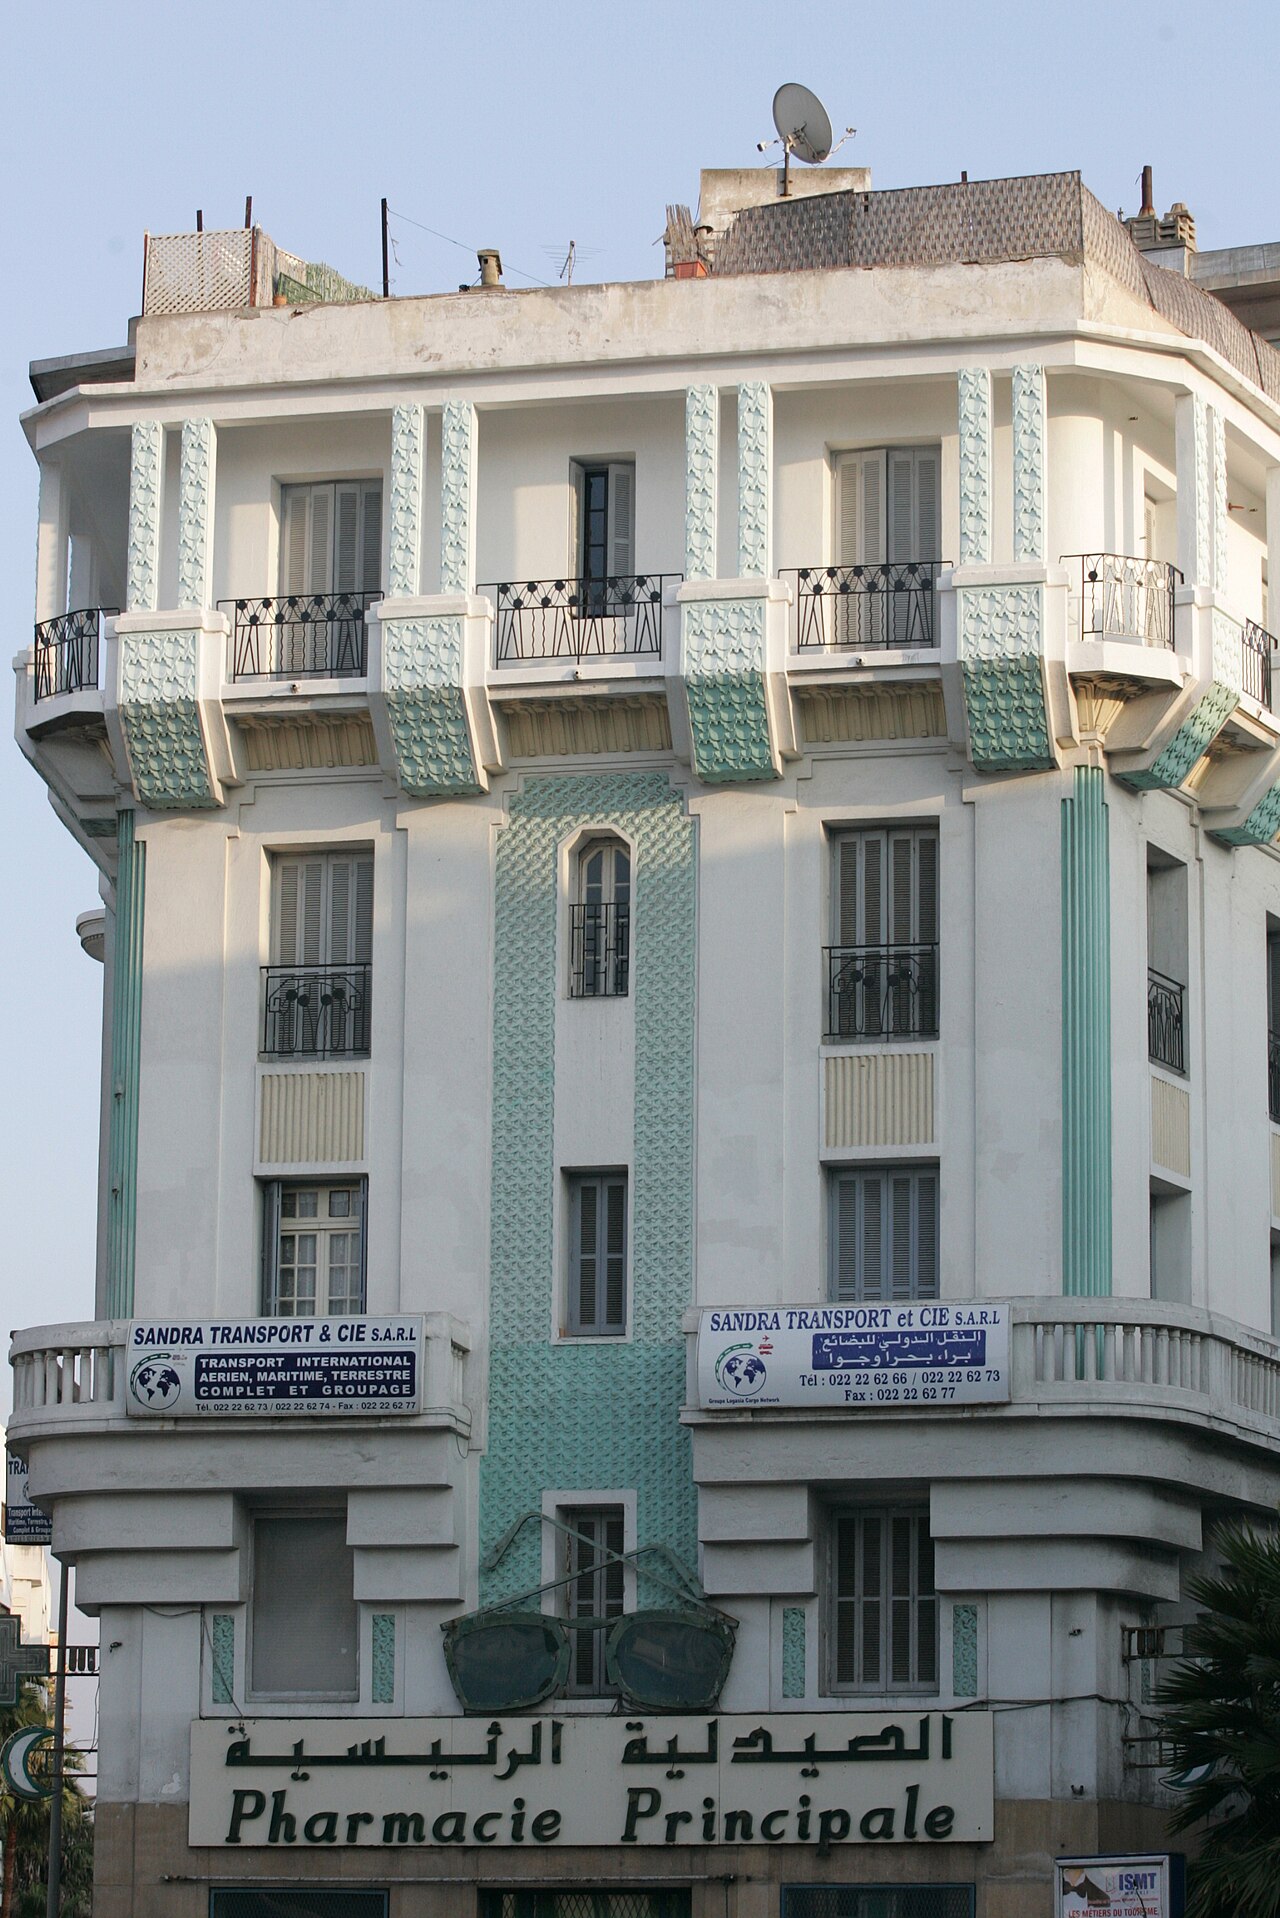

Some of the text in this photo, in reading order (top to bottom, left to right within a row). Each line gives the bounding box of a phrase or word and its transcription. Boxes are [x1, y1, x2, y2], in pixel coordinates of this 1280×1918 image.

[710, 1308, 1000, 1332] SANDRA TRANSPORT et CIE S.A.R.L
[134, 1324, 416, 1345] SANDRA TRANSPORT & CIE S.A.R.L
[200, 1356, 410, 1368] TRANSPORT INTERNATIONAL
[199, 1370, 410, 1384] AERIEN, MARITIME, TERRESTRE
[829, 1374, 851, 1386] 022
[855, 1374, 870, 1385] 22
[874, 1373, 888, 1384] 62
[892, 1372, 908, 1384] 66
[922, 1372, 944, 1384] 022
[948, 1372, 963, 1383] 22
[966, 1370, 982, 1382] 62
[986, 1370, 1000, 1382] 73
[200, 1384, 411, 1396] COMPLET ET GROUPAGE
[844, 1390, 867, 1401] Fax
[877, 1388, 900, 1400] 022
[903, 1388, 918, 1400] 22
[922, 1388, 937, 1400] 62
[940, 1388, 955, 1399] 77
[8, 1461, 28, 1474] TRA
[8, 1507, 45, 1518] Transport Inte
[225, 1714, 954, 1781] الصيدلية الرئيسية
[226, 1784, 954, 1856] Pharmacie Principale
[1120, 1872, 1156, 1891] ISMT
